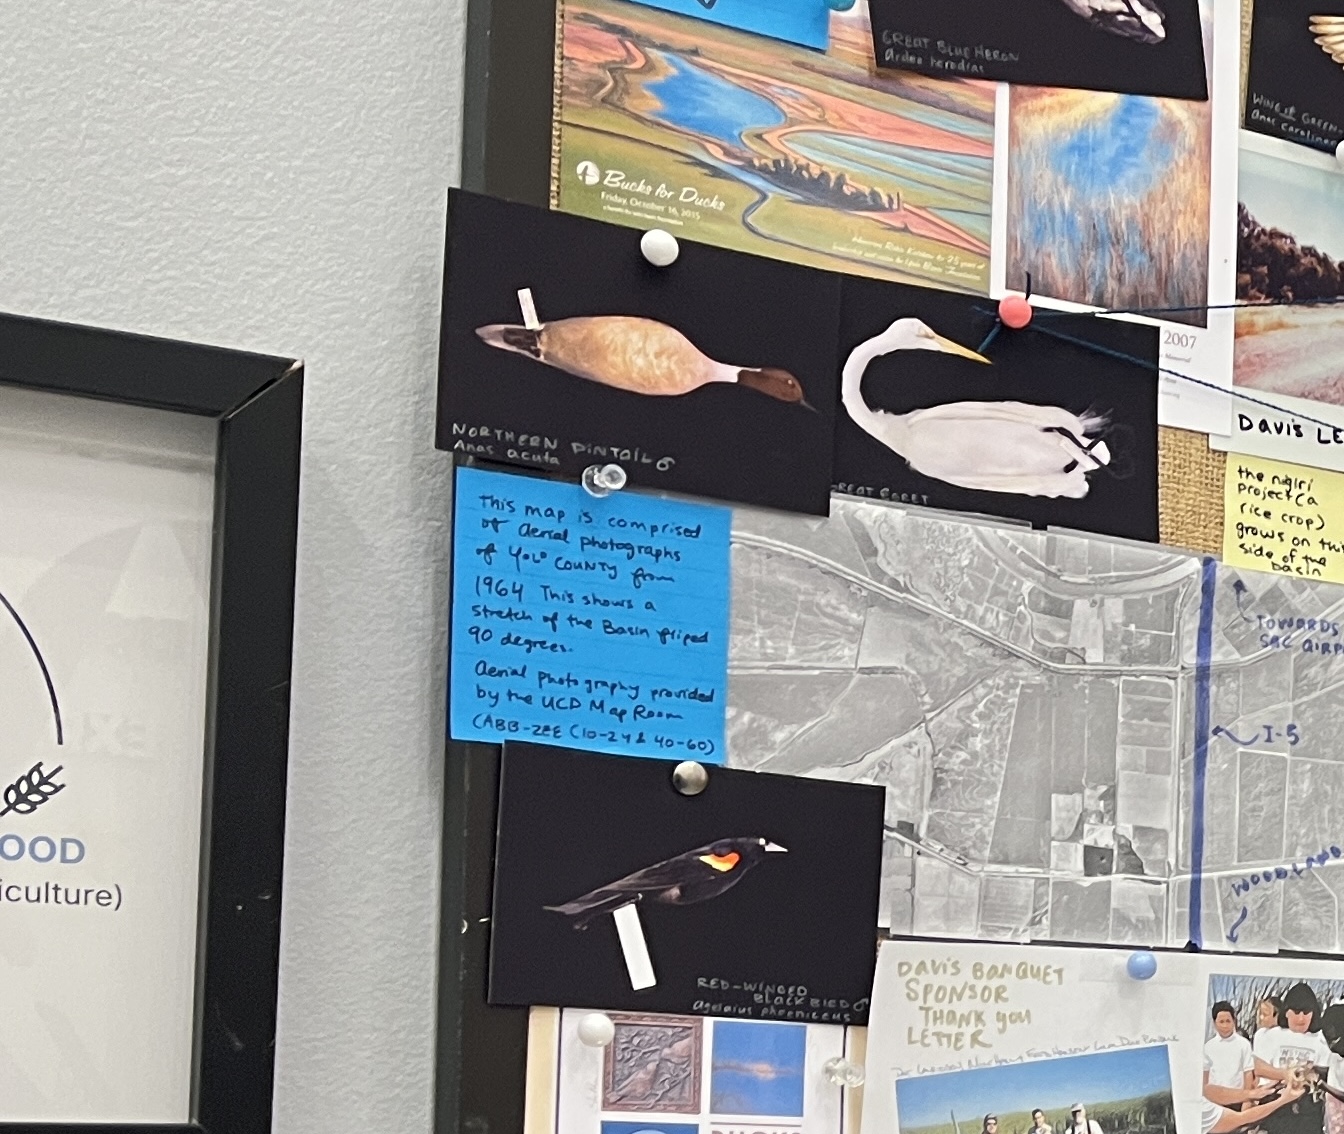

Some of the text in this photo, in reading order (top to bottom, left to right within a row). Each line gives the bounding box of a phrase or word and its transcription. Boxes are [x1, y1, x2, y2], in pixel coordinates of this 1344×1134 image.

[603, 170, 725, 211] Bucks for Ducks
[1163, 329, 1197, 349] 2007
[1237, 465, 1264, 482] the
[479, 495, 701, 539] This map is comprised
[1240, 503, 1325, 531] rice crop)
[1237, 522, 1285, 542] grows
[1292, 536, 1310, 547] on
[580, 536, 681, 563] photographs
[1282, 550, 1297, 564] of
[476, 543, 675, 588] of from
[475, 575, 634, 611] 1964 This shows
[472, 603, 532, 622] stretch
[543, 612, 558, 632] of
[603, 619, 650, 637] Basin
[468, 625, 492, 644] 90
[476, 684, 499, 707] by
[541, 695, 581, 711] UCD
[589, 699, 627, 722] Map
[652, 686, 715, 703] provided
[971, 961, 1064, 983] BANQUET
[906, 980, 1009, 1004] SPONSOR
[919, 1006, 985, 1029] THANK
[907, 1024, 992, 1049] LETTER
